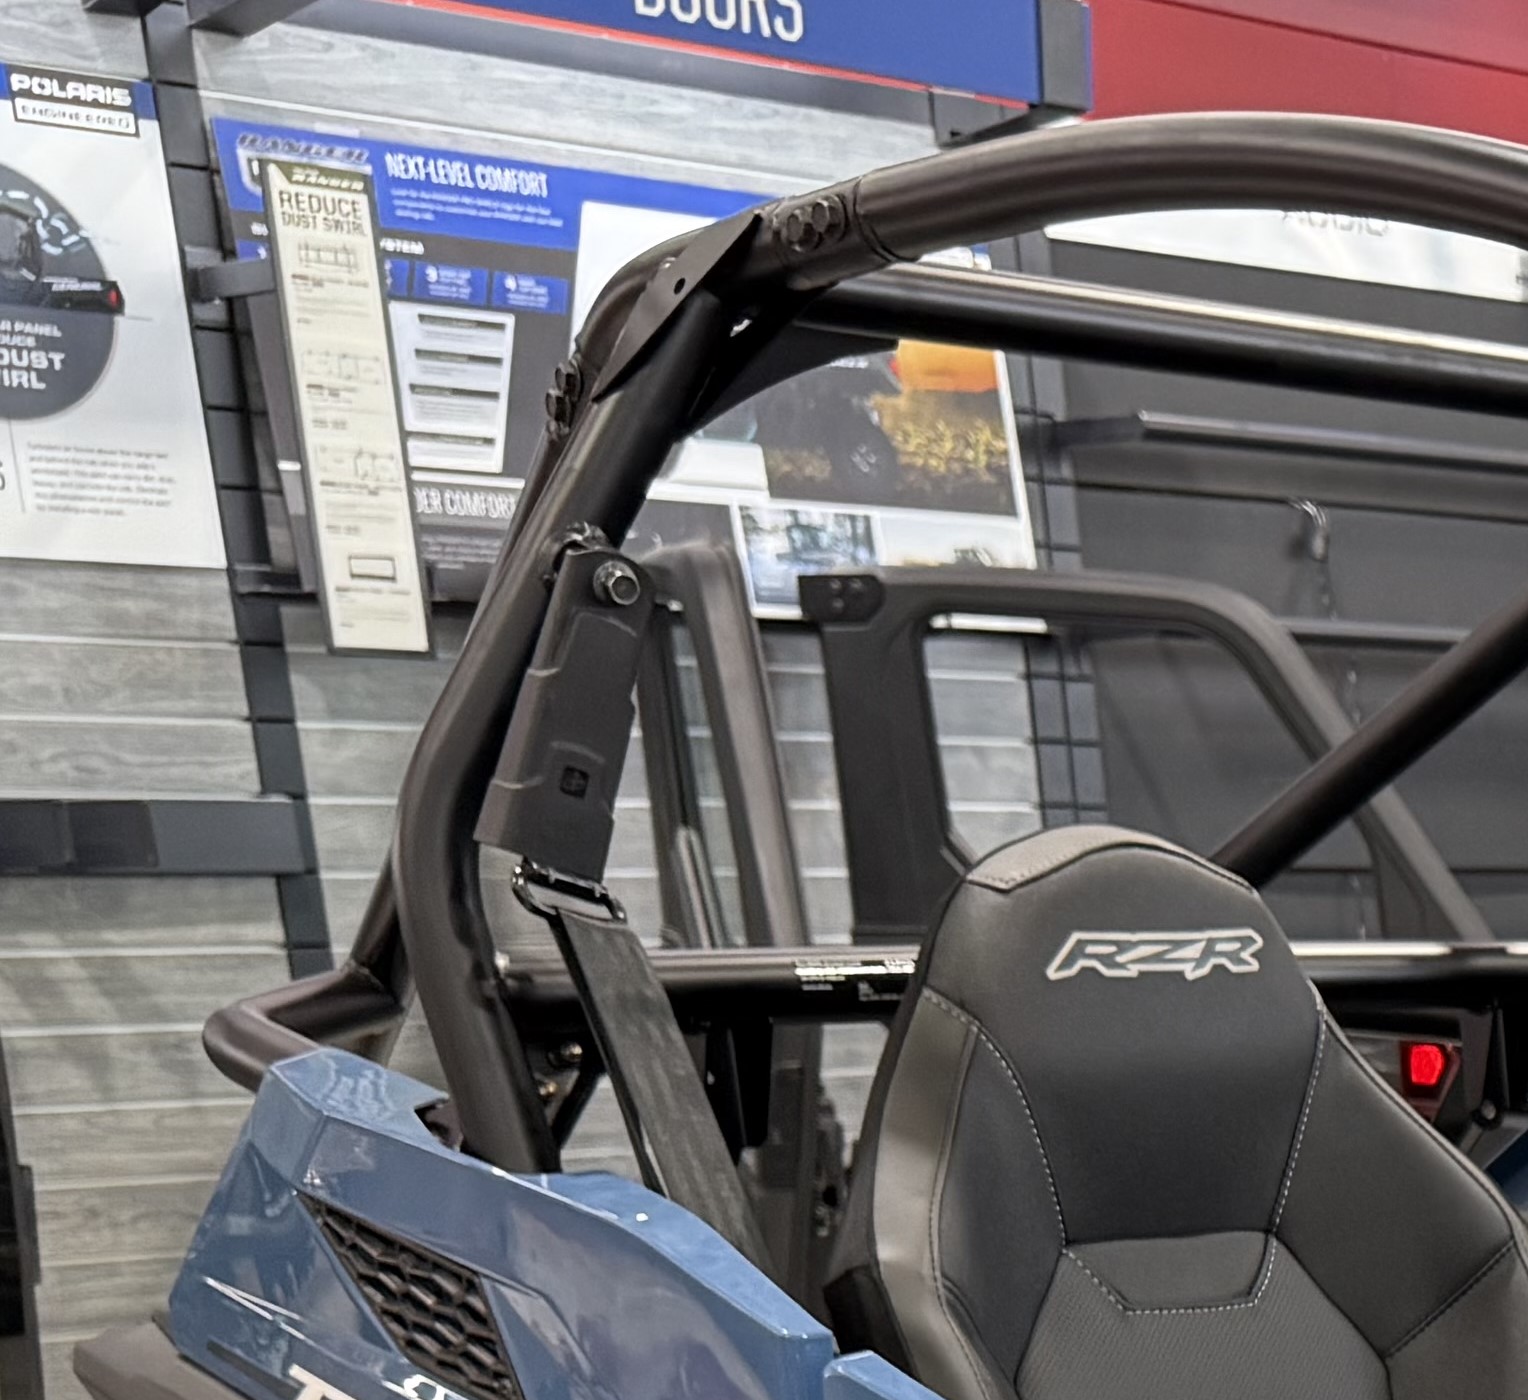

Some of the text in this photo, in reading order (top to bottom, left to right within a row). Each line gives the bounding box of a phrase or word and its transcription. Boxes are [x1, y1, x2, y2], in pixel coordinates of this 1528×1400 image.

[10, 73, 132, 106] POLARIS
[278, 190, 362, 221] REDUCE
[282, 211, 317, 230] DUST
[0, 368, 47, 390] IRL
[1046, 928, 1264, 980] RZR
